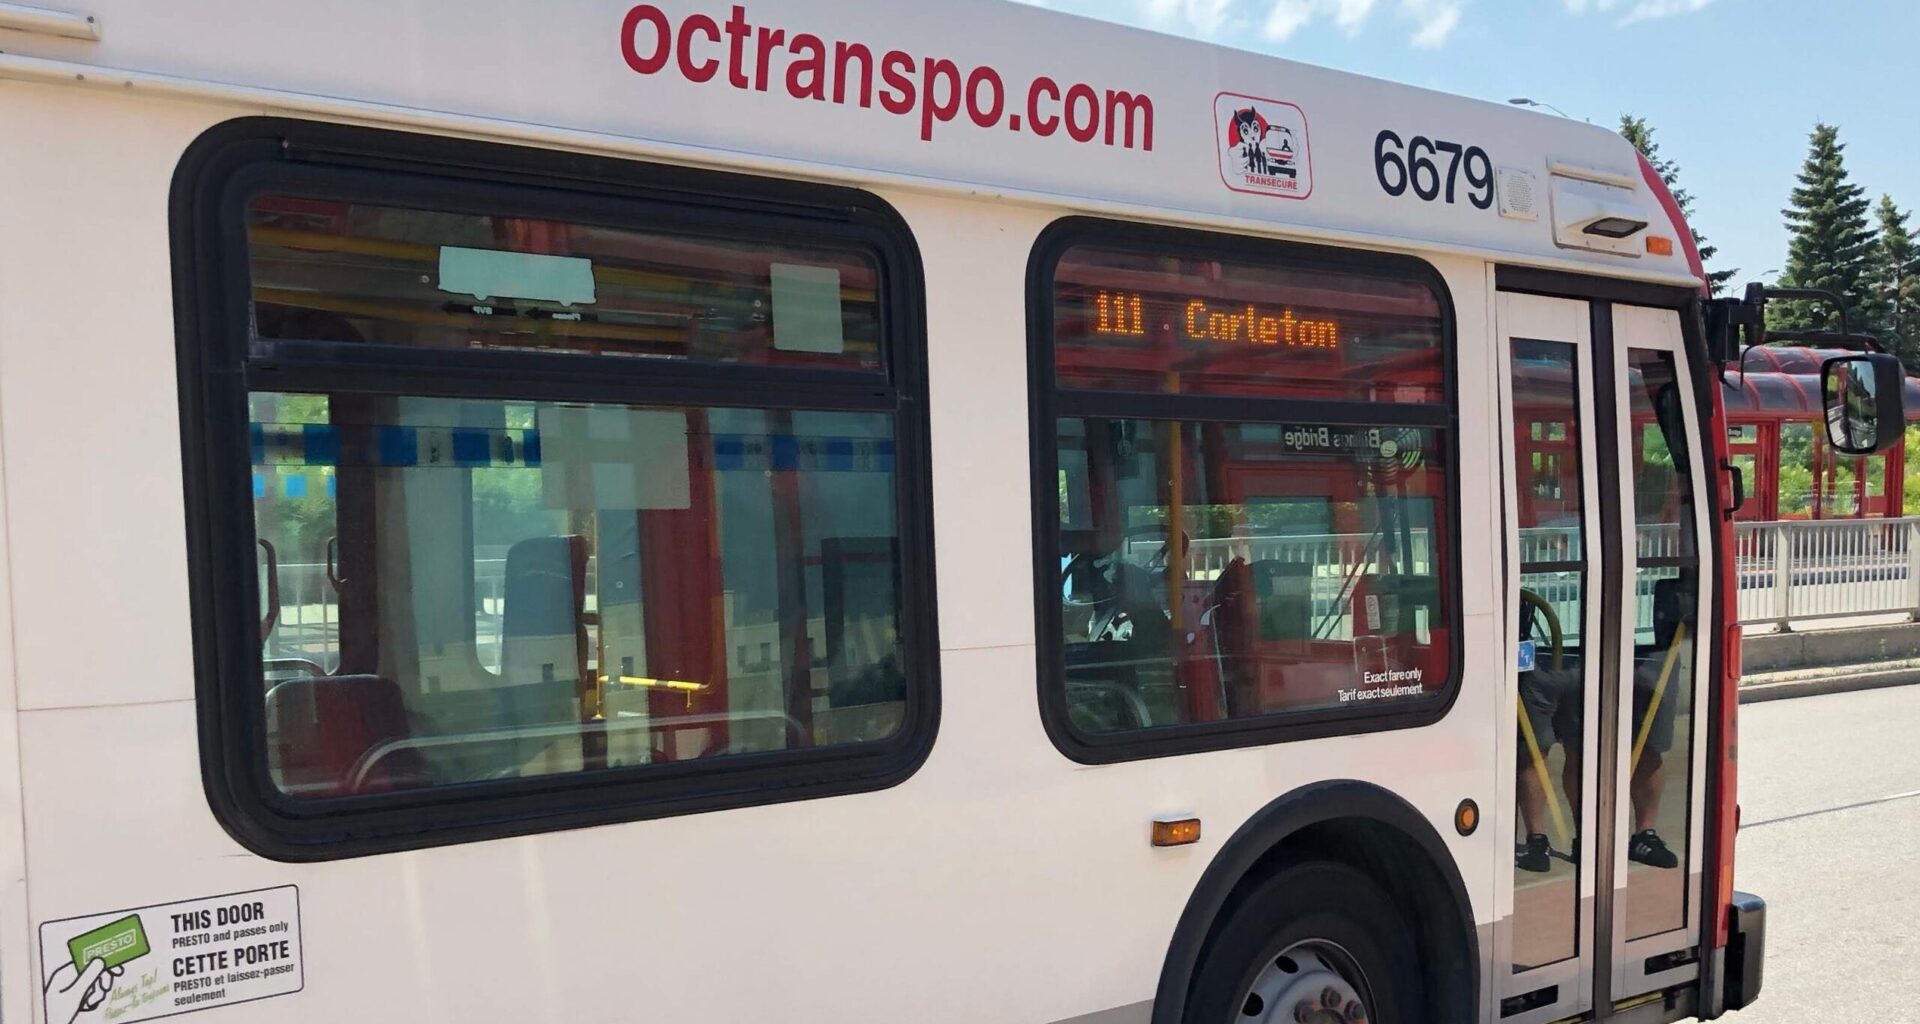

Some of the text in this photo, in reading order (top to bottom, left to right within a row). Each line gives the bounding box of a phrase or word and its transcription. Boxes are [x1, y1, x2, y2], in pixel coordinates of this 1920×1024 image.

[620, 4, 1154, 151] octranspo.com
[1245, 175, 1298, 190] TRANSECURE
[1374, 129, 1494, 210] 6679
[1096, 290, 1338, 348] 111 Carleton
[1364, 667, 1422, 684] Exact fare only
[1338, 682, 1423, 702] Tarif exact seulement
[171, 902, 264, 933] THIS DOOR
[87, 934, 133, 960] PRESTO
[172, 921, 289, 948] PRESTO and passes only
[173, 940, 290, 977] CETTE PORTE
[173, 963, 295, 992] PRESTO et laissez-passer
[174, 988, 226, 1006] seulement
